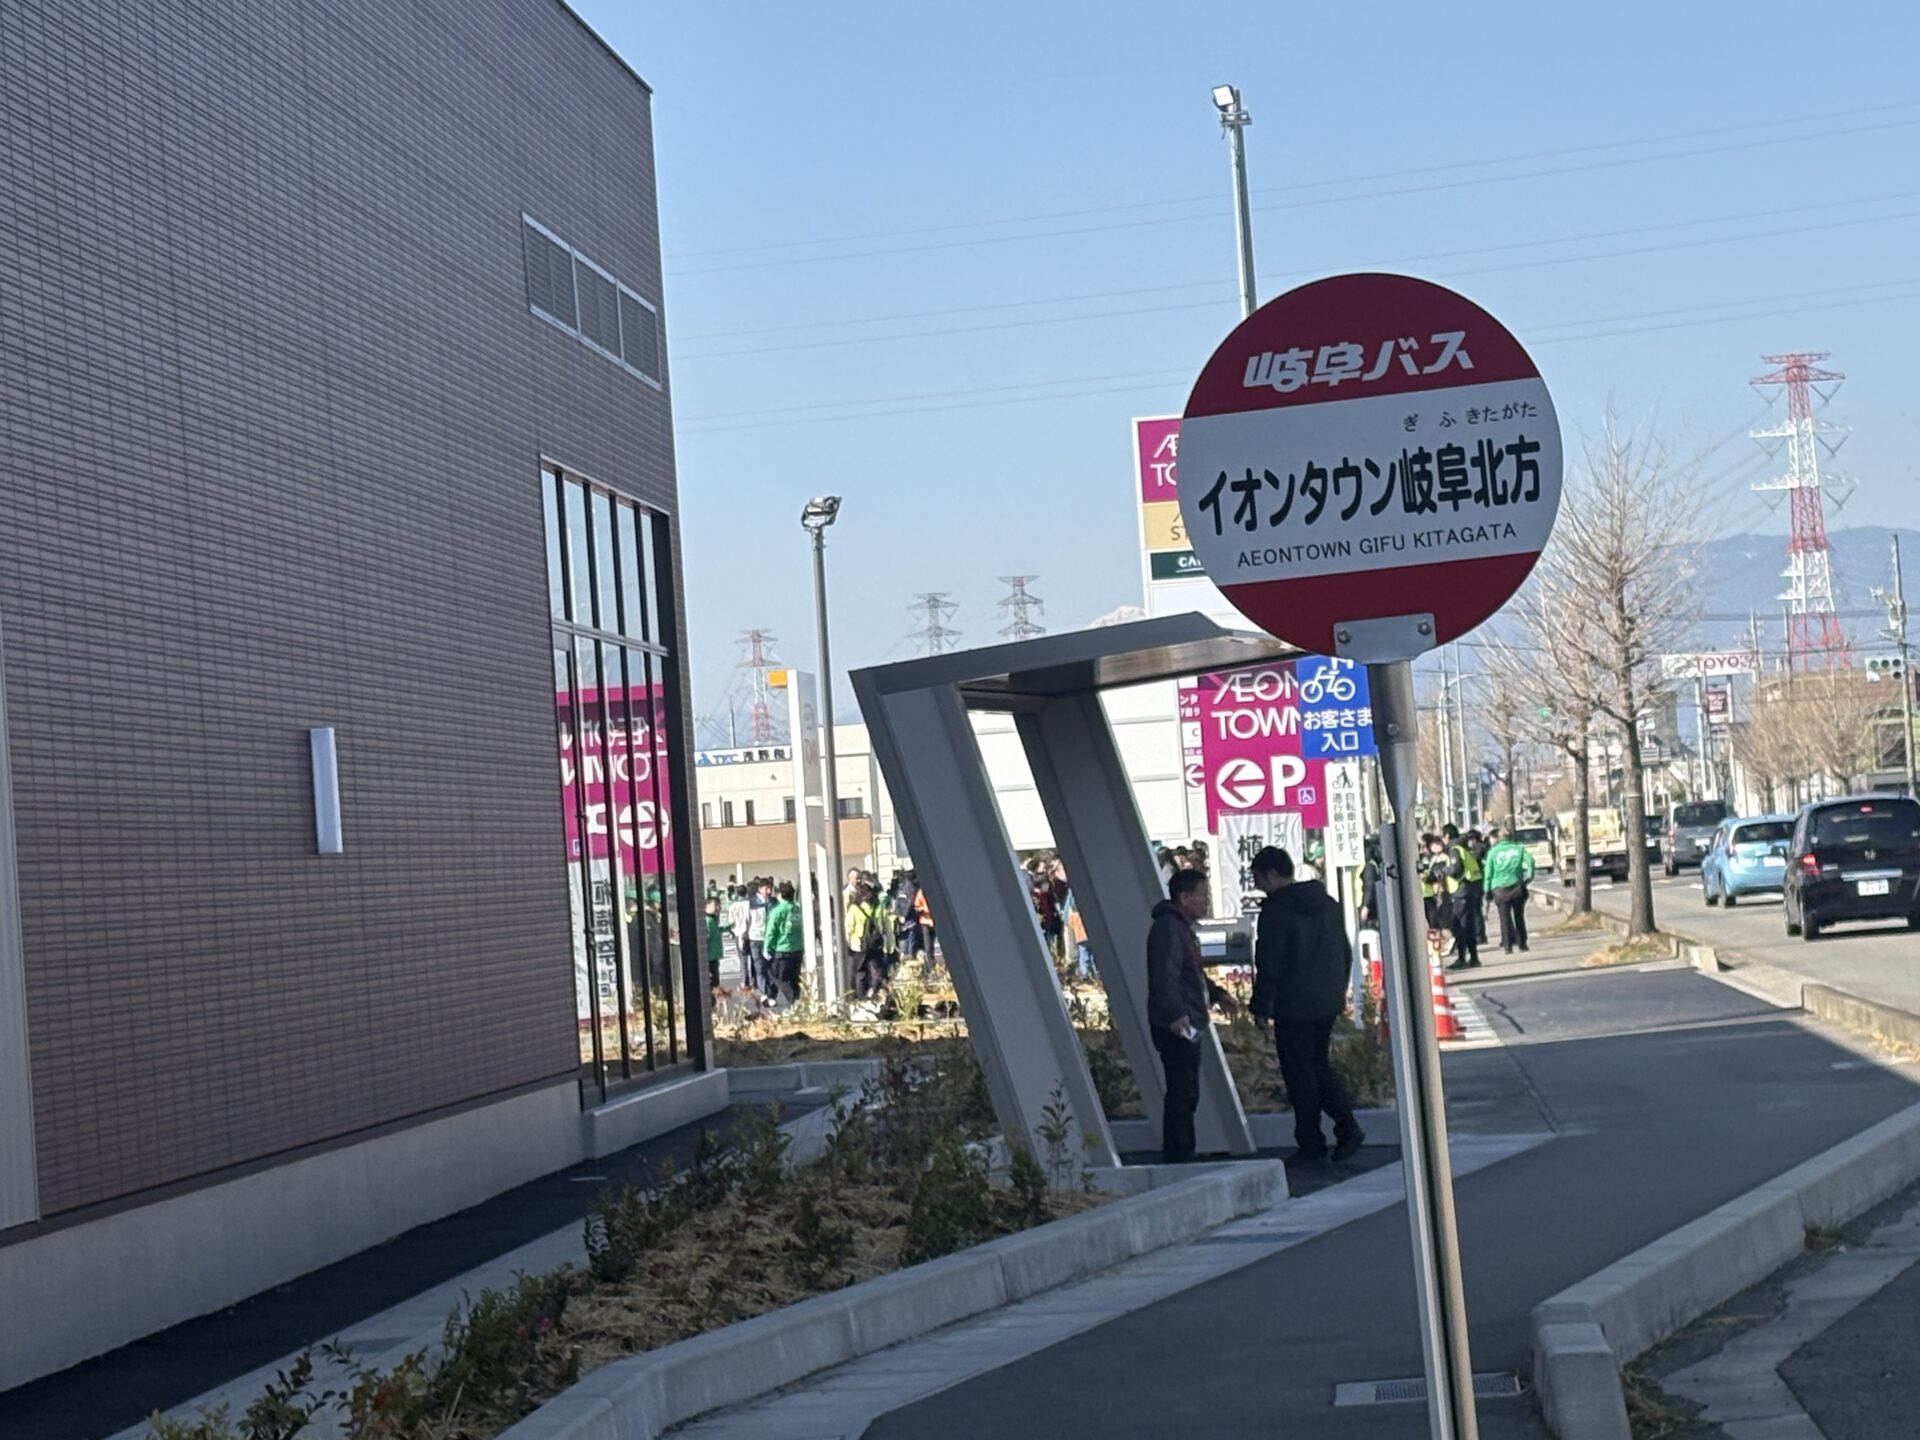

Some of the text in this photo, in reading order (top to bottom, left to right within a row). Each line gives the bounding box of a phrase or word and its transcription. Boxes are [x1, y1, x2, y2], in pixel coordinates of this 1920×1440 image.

[1243, 331, 1474, 393] 岐阜バス
[1199, 434, 1541, 536] イオンタウン岐阜北方
[1237, 522, 1517, 568] AEONTOWN GIFU KITAGATA
[1303, 707, 1373, 730] お客さま
[1321, 731, 1359, 752] 入口
[1270, 755, 1306, 806] P
